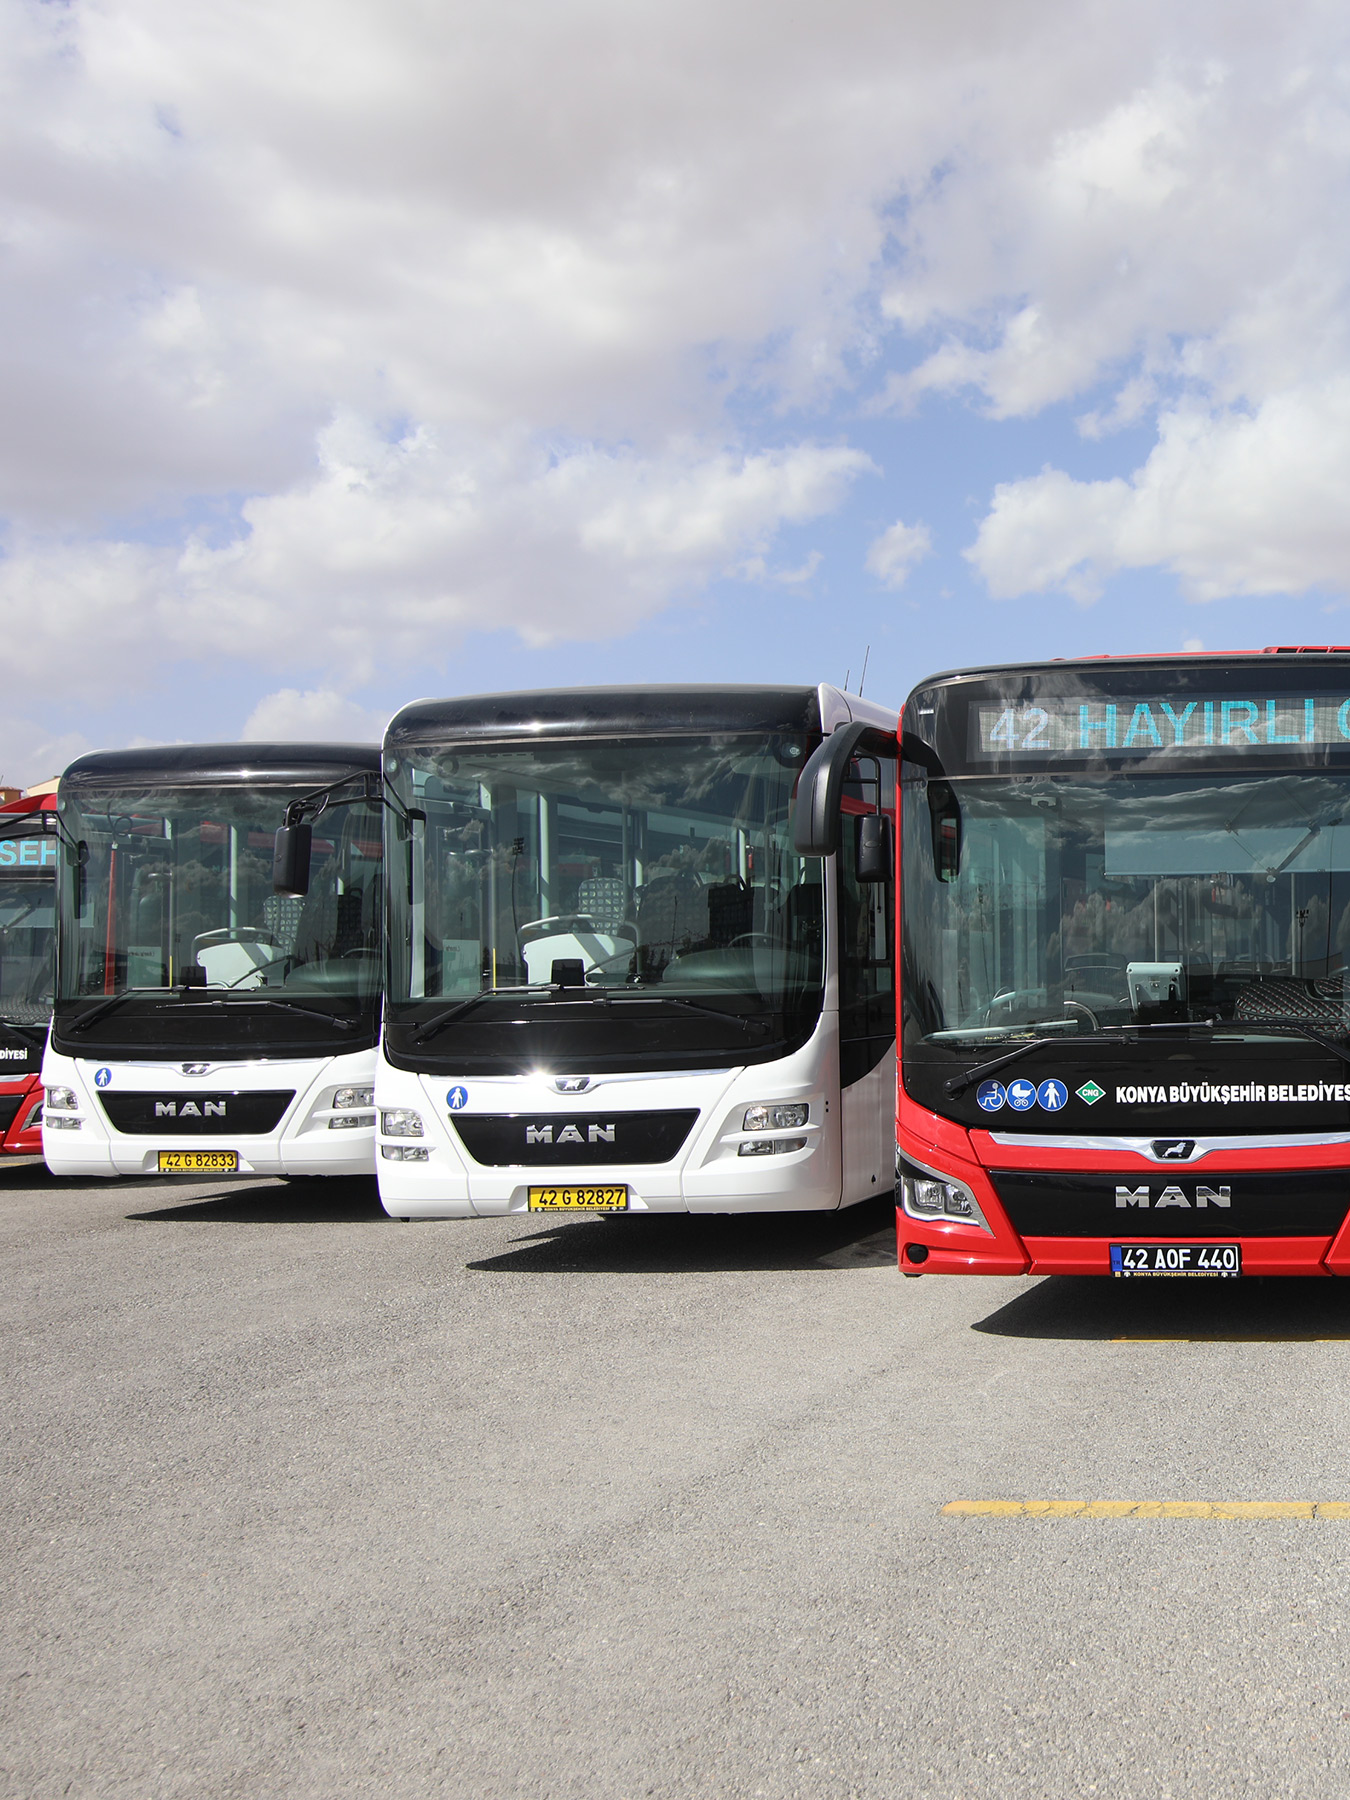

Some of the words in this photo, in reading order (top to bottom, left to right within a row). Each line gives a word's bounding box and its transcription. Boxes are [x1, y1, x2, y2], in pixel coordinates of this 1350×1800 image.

[990, 708, 1050, 749] 42
[1080, 699, 1315, 748] HAYIRLI
[1082, 1089, 1099, 1097] CNG
[1116, 1086, 1167, 1103] KONYA
[1169, 1081, 1266, 1105] BÜYÜKŞEHİR
[155, 1101, 226, 1116] MAN
[526, 1124, 616, 1144] MAN
[166, 1154, 181, 1167] 42
[185, 1154, 192, 1167] G
[196, 1154, 234, 1167] 82833
[539, 1190, 557, 1206] 42
[562, 1190, 571, 1205] G
[577, 1189, 624, 1205] 82827
[1115, 1186, 1231, 1208] MAN
[1123, 1249, 1149, 1269] 42
[1154, 1249, 1191, 1269] AOF
[1197, 1249, 1235, 1269] 440
